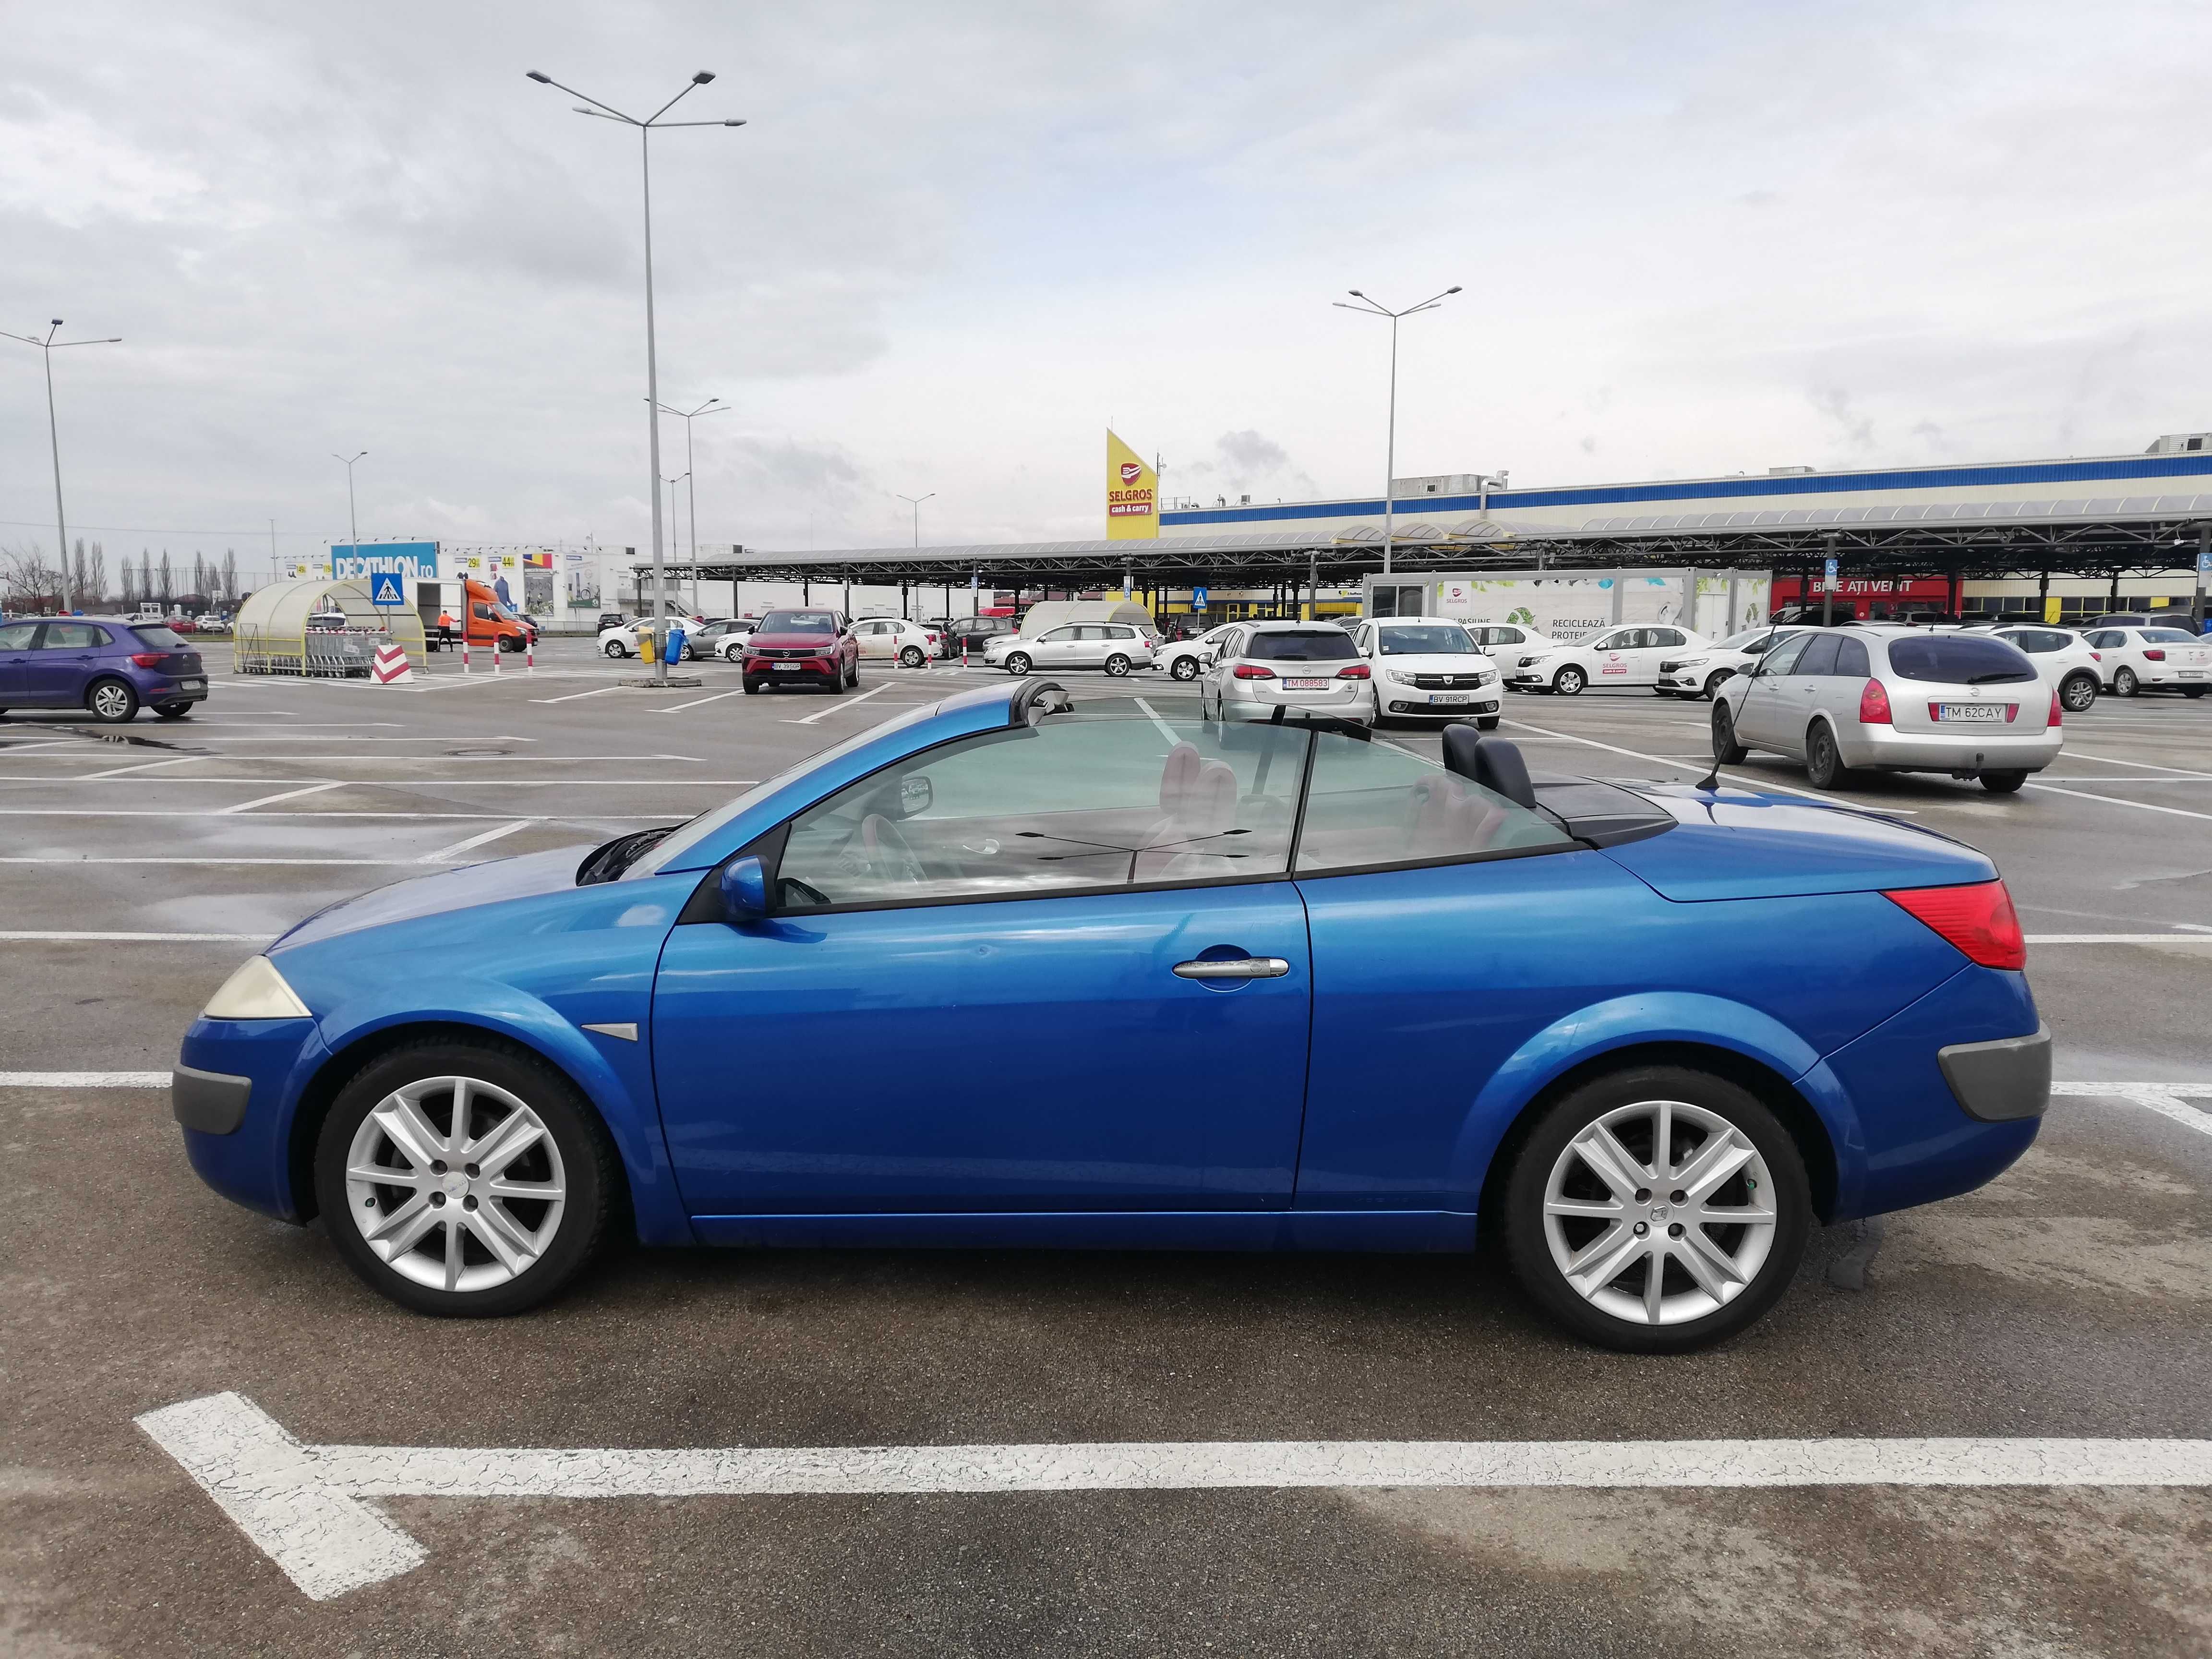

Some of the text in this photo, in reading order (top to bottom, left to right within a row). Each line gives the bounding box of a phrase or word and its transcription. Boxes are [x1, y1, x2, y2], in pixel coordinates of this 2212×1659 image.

[1109, 489, 1152, 502] SELGROS
[1132, 505, 1149, 513] carry
[468, 558, 476, 567] 29
[502, 557, 511, 566] 44
[1847, 580, 1867, 595] AȚI
[1552, 617, 1605, 627] RECICLEAZĂ
[1946, 708, 2001, 718] TM 62CAY
